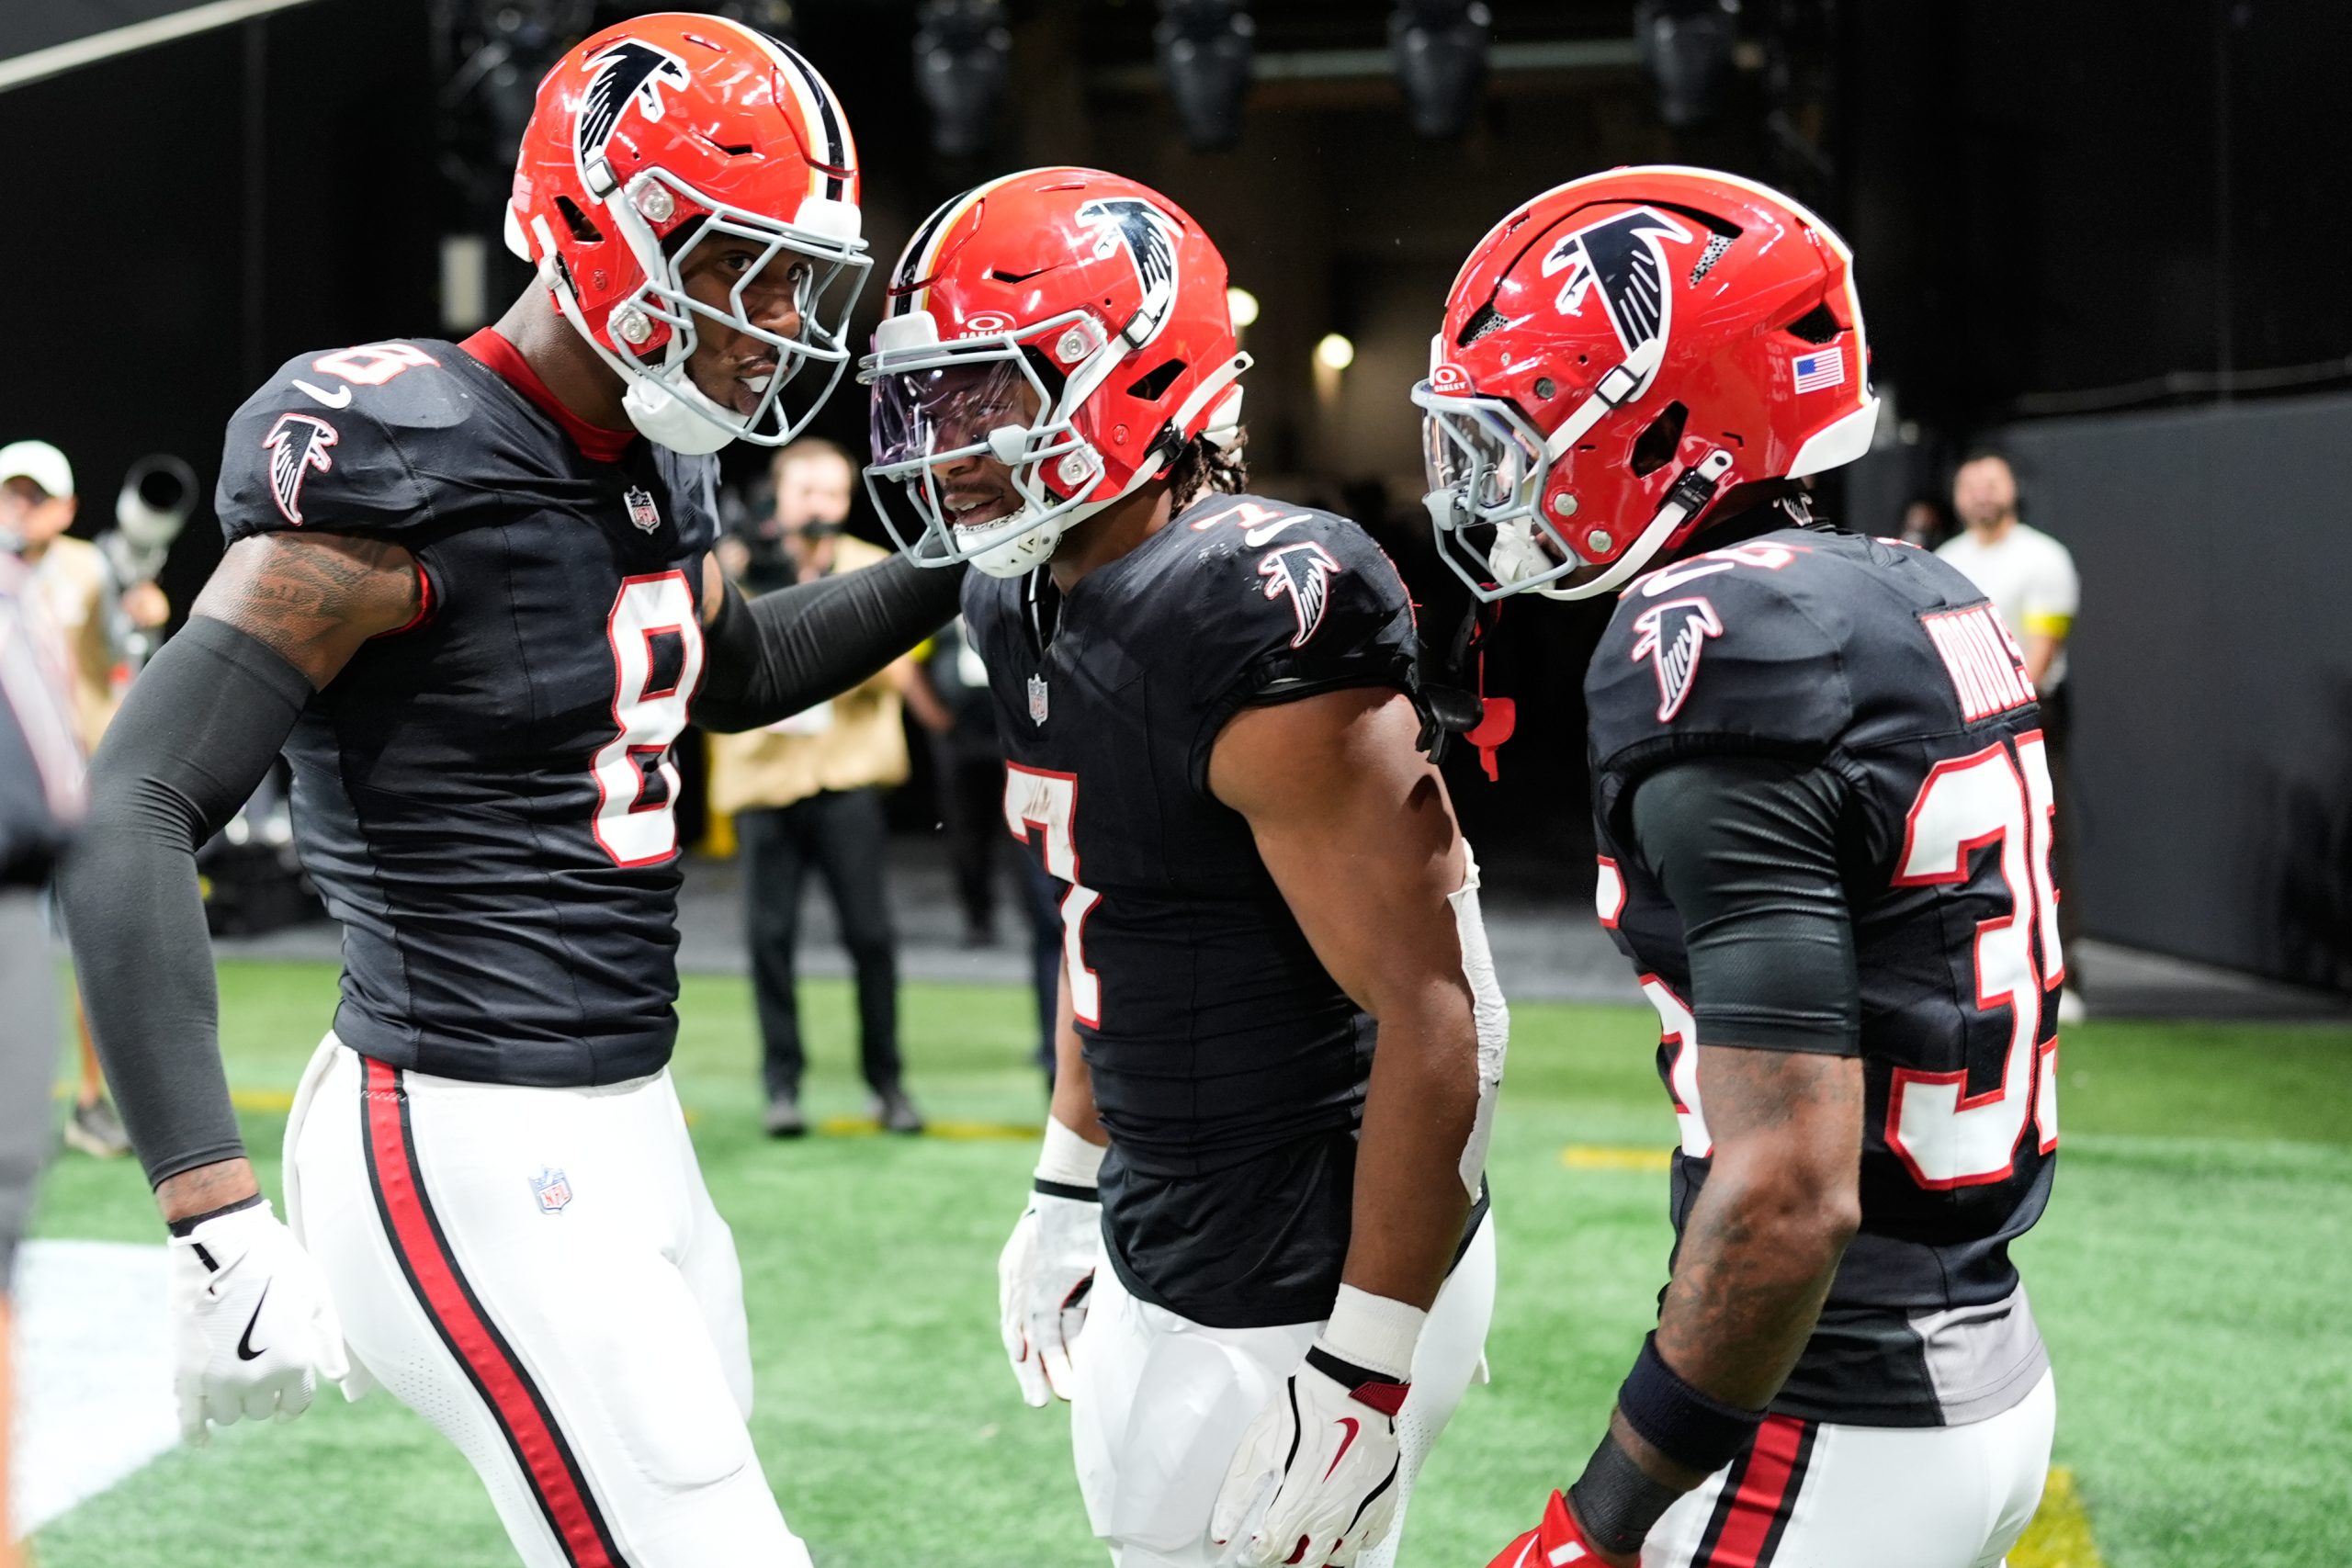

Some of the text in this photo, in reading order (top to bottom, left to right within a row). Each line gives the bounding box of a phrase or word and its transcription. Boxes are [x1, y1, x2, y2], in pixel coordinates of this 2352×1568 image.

[1433, 381, 1467, 393] OAKLEY
[590, 569, 706, 868] 8
[1002, 759, 1102, 1031] 7
